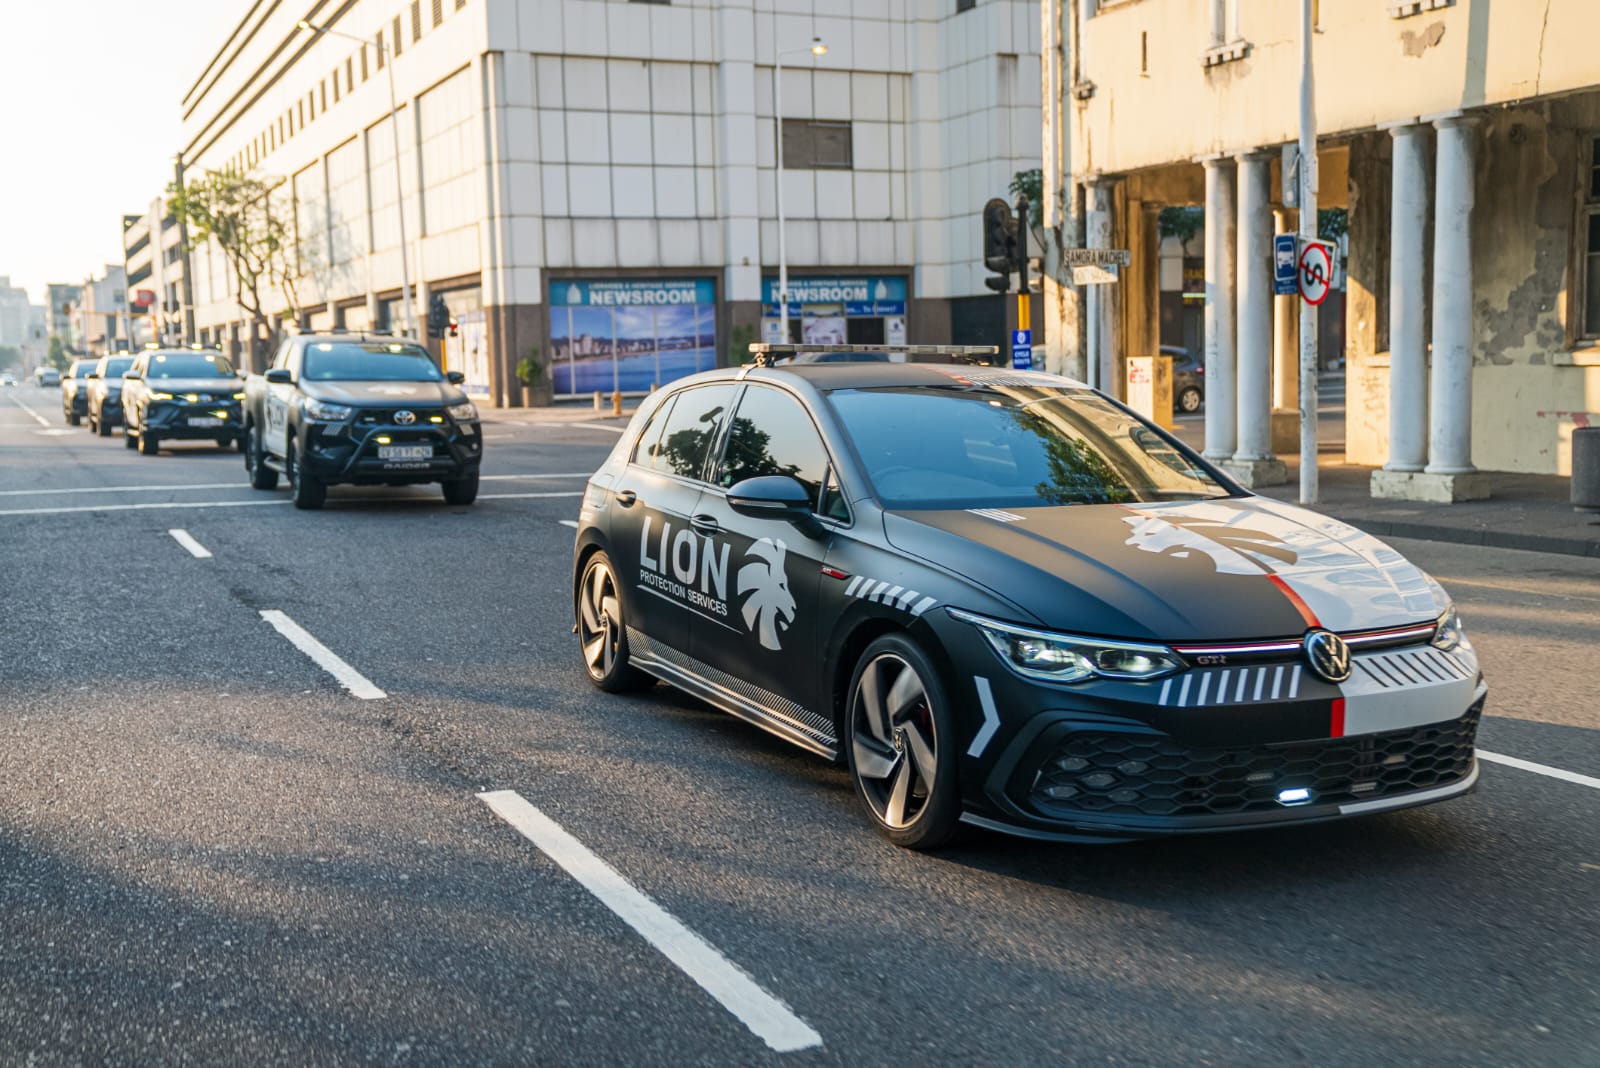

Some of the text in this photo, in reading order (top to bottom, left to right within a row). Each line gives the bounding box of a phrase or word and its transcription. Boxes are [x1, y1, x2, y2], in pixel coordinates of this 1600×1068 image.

[1064, 249, 1096, 265] SAMORA
[1097, 250, 1126, 266] MACHEL
[589, 289, 696, 305] NEWSROOM
[771, 287, 868, 302] NEWSROOM
[640, 515, 731, 601] LION
[639, 569, 728, 616] PROTECTION SERVICES
